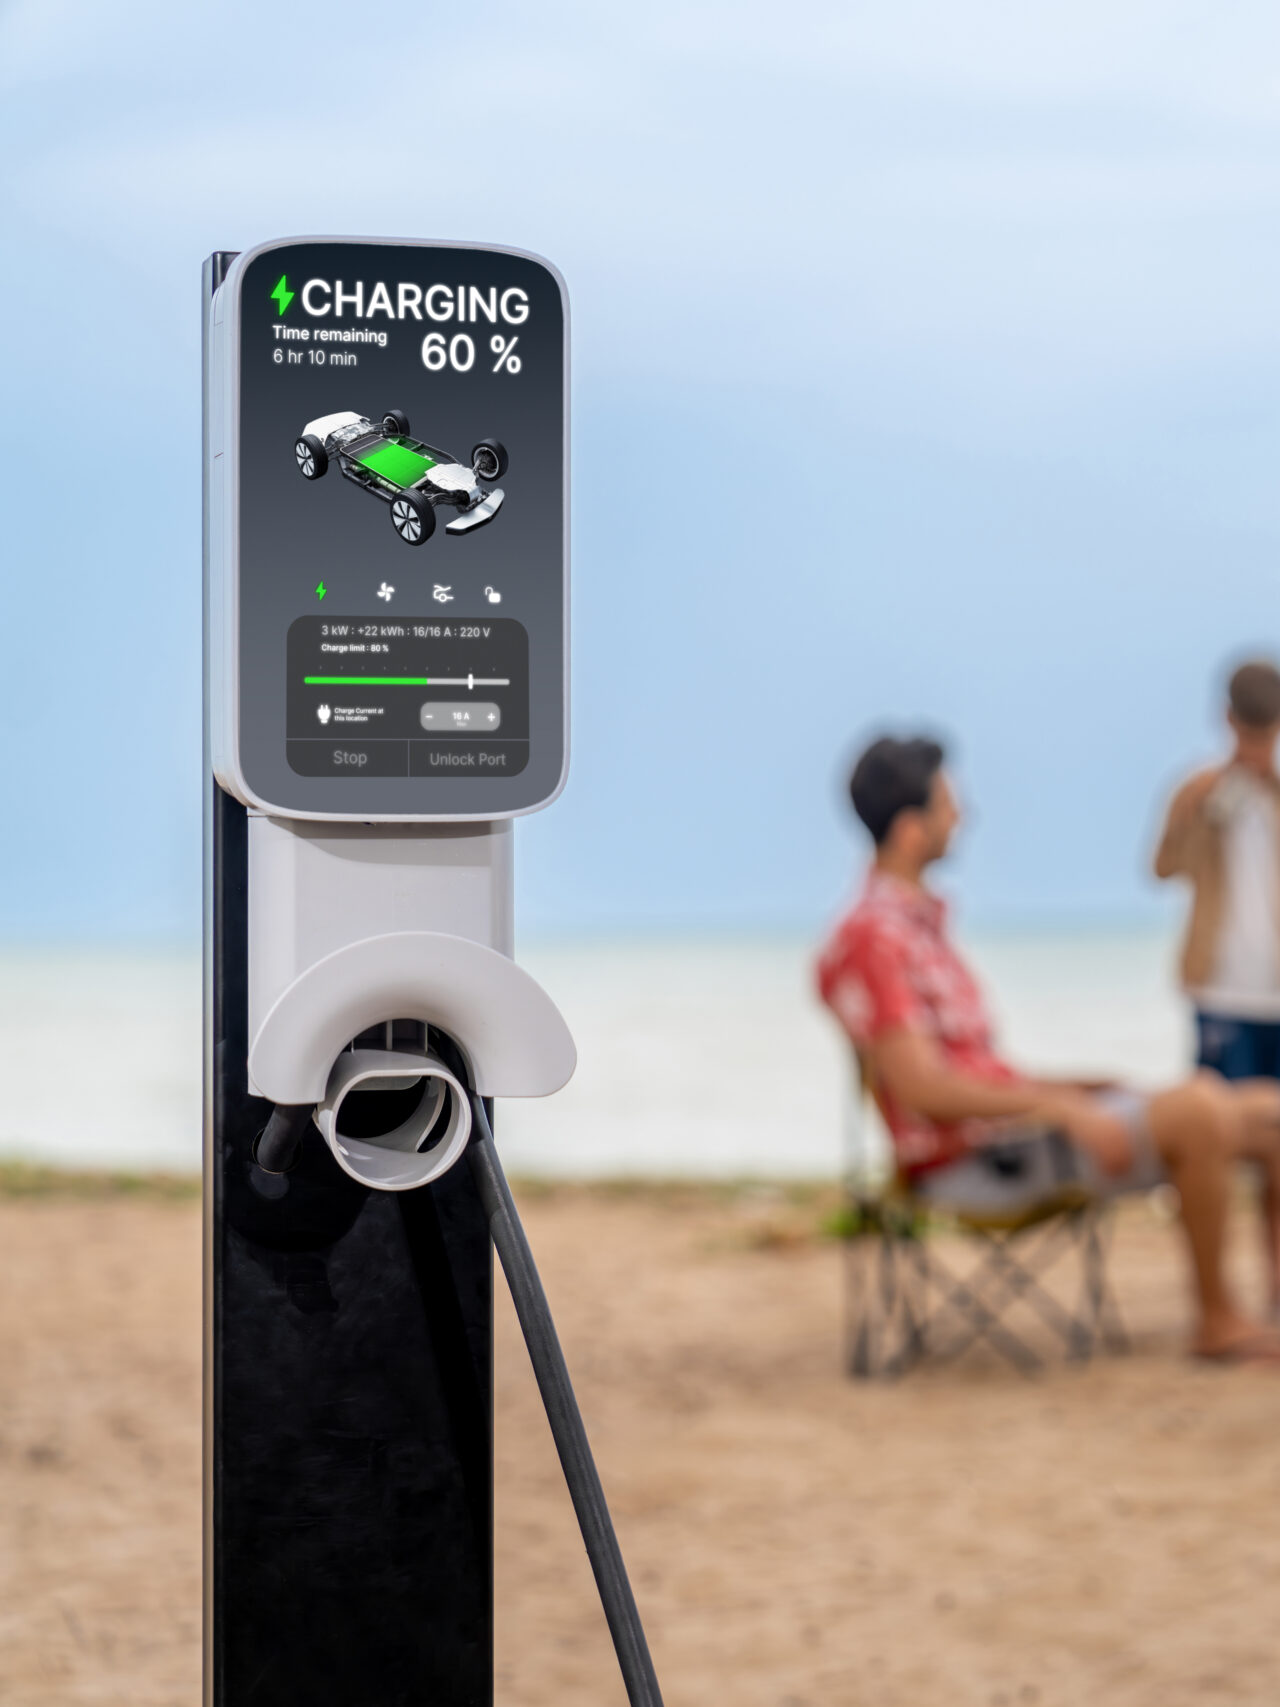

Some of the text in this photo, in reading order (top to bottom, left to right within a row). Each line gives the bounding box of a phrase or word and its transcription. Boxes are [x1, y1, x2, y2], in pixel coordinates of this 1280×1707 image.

[302, 279, 529, 325] CHARGING
[272, 325, 387, 347] Time remaining
[273, 348, 357, 366] 6 hr 10 min
[422, 332, 521, 374] 60 %
[322, 625, 329, 636] 3
[331, 626, 348, 635] kW
[358, 625, 378, 636] +22
[380, 626, 404, 636] kWh
[413, 626, 441, 638] 16/16
[444, 627, 451, 637] A
[460, 627, 480, 638] 220
[483, 627, 490, 638] V
[321, 643, 349, 653] Charge
[349, 644, 365, 652] limit
[334, 707, 355, 715] Charge
[463, 712, 470, 720] A
[334, 750, 367, 767] Stop
[430, 753, 506, 766] Unlock Port
